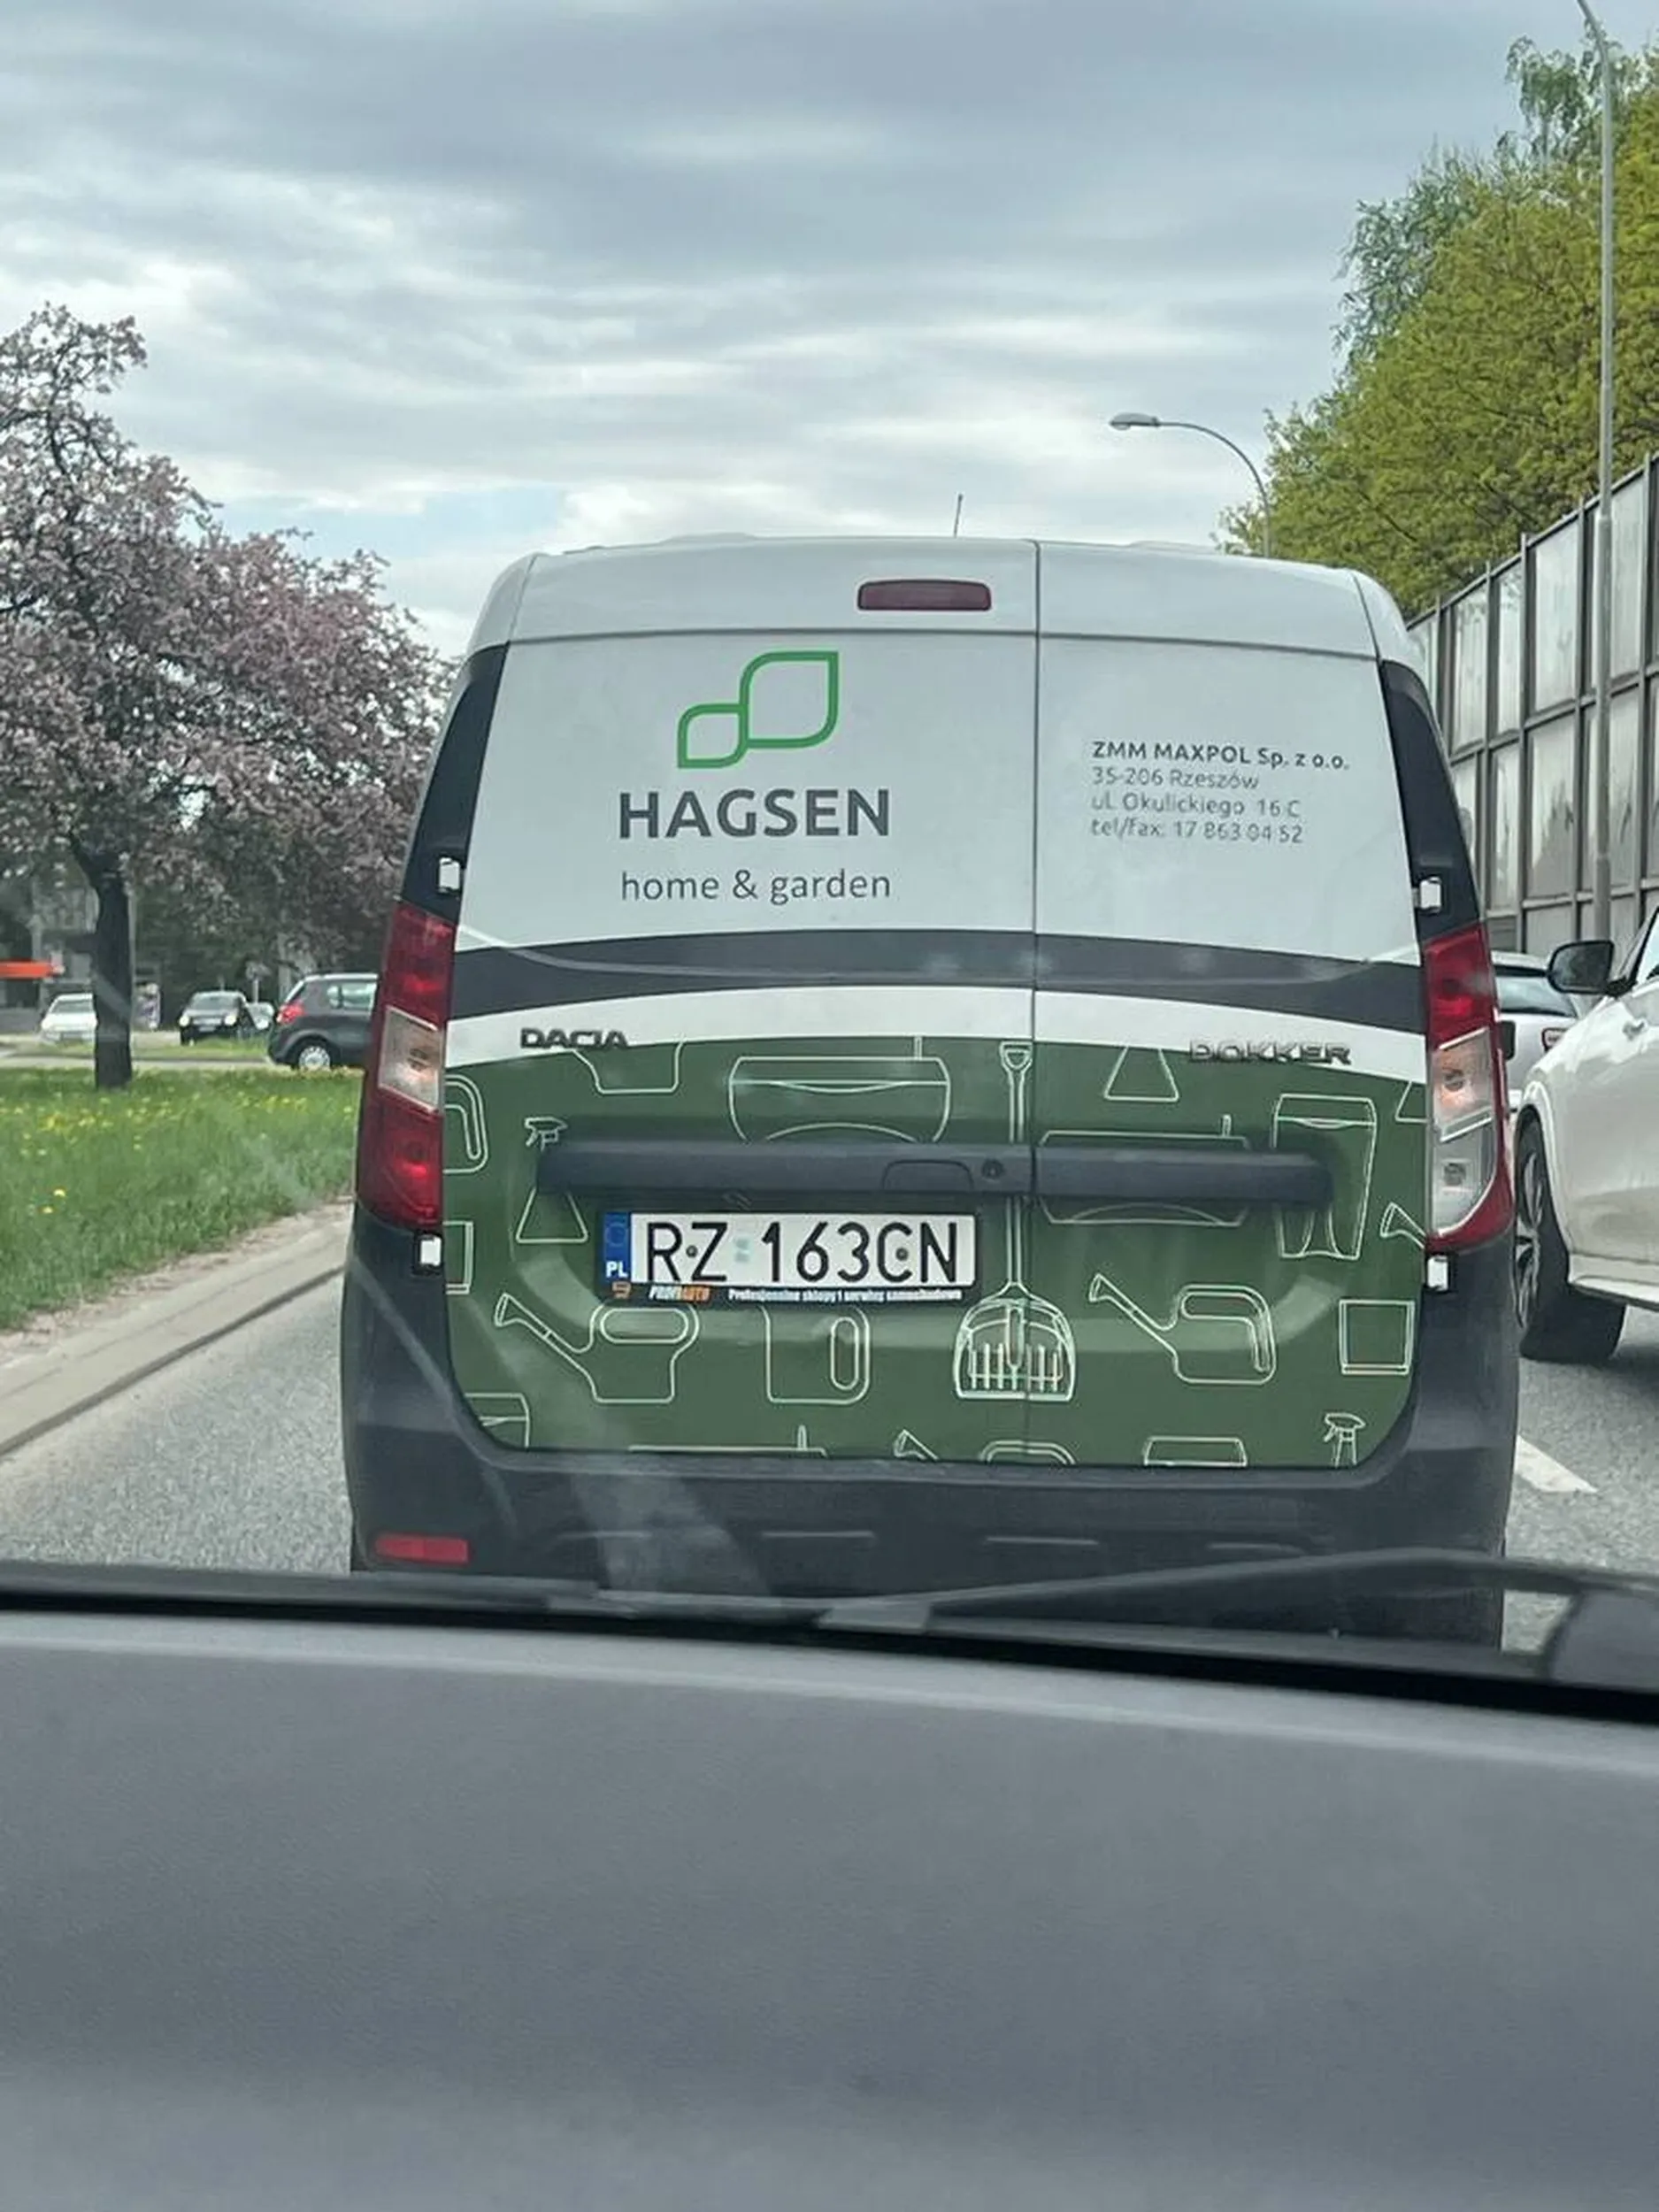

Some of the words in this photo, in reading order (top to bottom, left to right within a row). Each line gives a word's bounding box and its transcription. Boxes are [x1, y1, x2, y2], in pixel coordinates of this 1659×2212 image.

[1093, 741, 1148, 760] ZMM
[1154, 742, 1251, 764] MAXPOL
[1257, 747, 1290, 770] Sp.
[1294, 753, 1306, 767] z
[1312, 753, 1350, 771] o.o.
[1092, 766, 1164, 786] 35-206
[1170, 768, 1259, 789] Rzeszów
[619, 788, 889, 839] HAGSEN
[1122, 791, 1246, 818] Okulickiego
[1257, 798, 1281, 818] 16
[1286, 799, 1302, 818] C
[1173, 820, 1197, 838] 17
[1203, 820, 1241, 841] 863
[1279, 824, 1304, 844] 52
[621, 870, 719, 901] home
[733, 869, 758, 900] &
[770, 869, 891, 906] garden
[519, 1027, 629, 1051] DACIA
[1189, 1039, 1352, 1066] DOKKER
[647, 1222, 728, 1282] RZ
[761, 1222, 957, 1283] 163CN
[605, 1261, 628, 1279] PL
